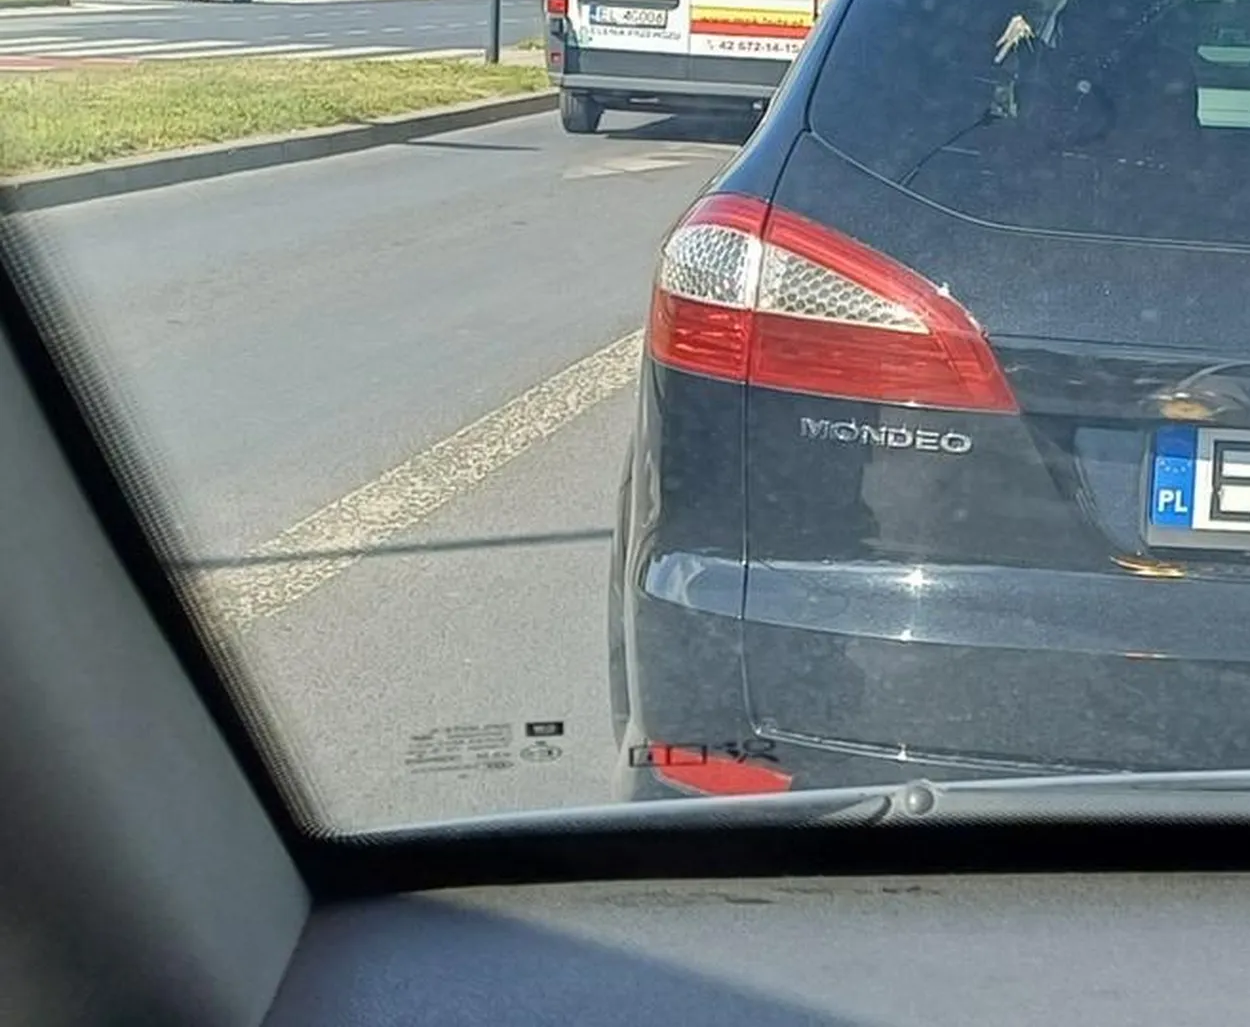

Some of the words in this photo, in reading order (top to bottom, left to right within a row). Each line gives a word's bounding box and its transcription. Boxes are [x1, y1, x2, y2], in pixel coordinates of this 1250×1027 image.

[719, 39, 735, 50] 42
[800, 417, 972, 453] MONDEO
[1158, 488, 1188, 513] PL
